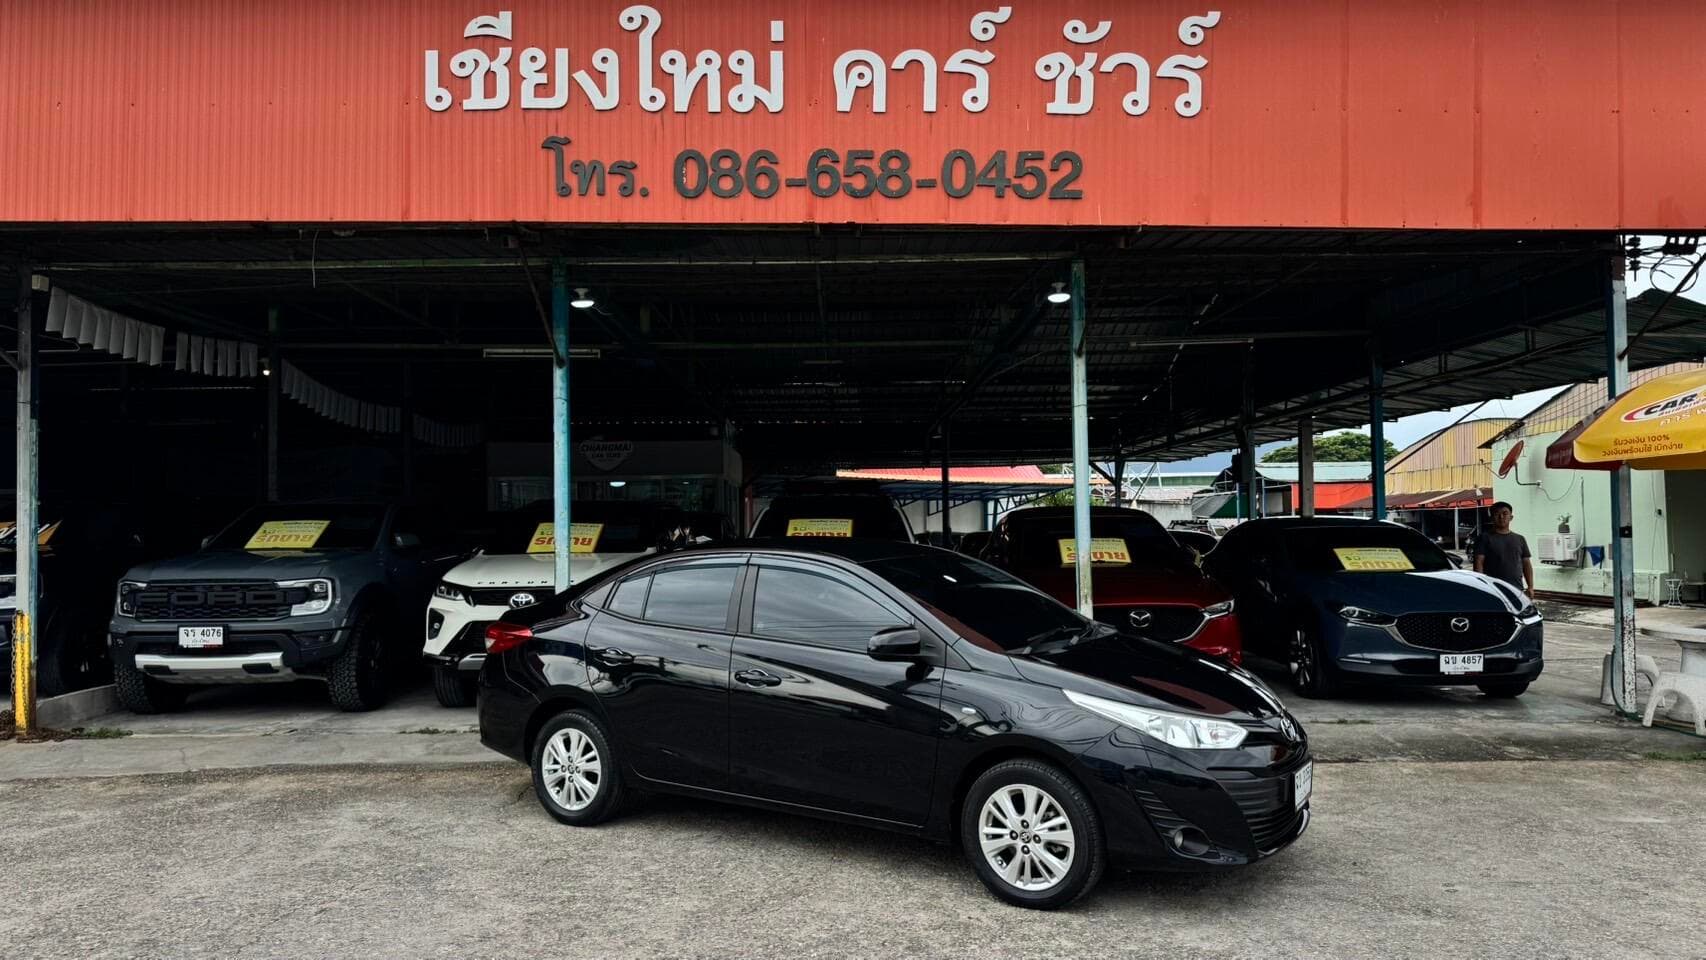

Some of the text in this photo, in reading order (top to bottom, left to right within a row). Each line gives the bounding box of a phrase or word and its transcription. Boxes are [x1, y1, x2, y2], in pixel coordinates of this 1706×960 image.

[425, 5, 1221, 117] เชียงใหม่ คาร์ ชัวร์
[541, 136, 1083, 200] โทร. 086-658-0452
[1644, 393, 1697, 415] CAR
[1647, 433, 1670, 442] 100%
[200, 628, 222, 638] 4076
[1461, 655, 1482, 665] 4857
